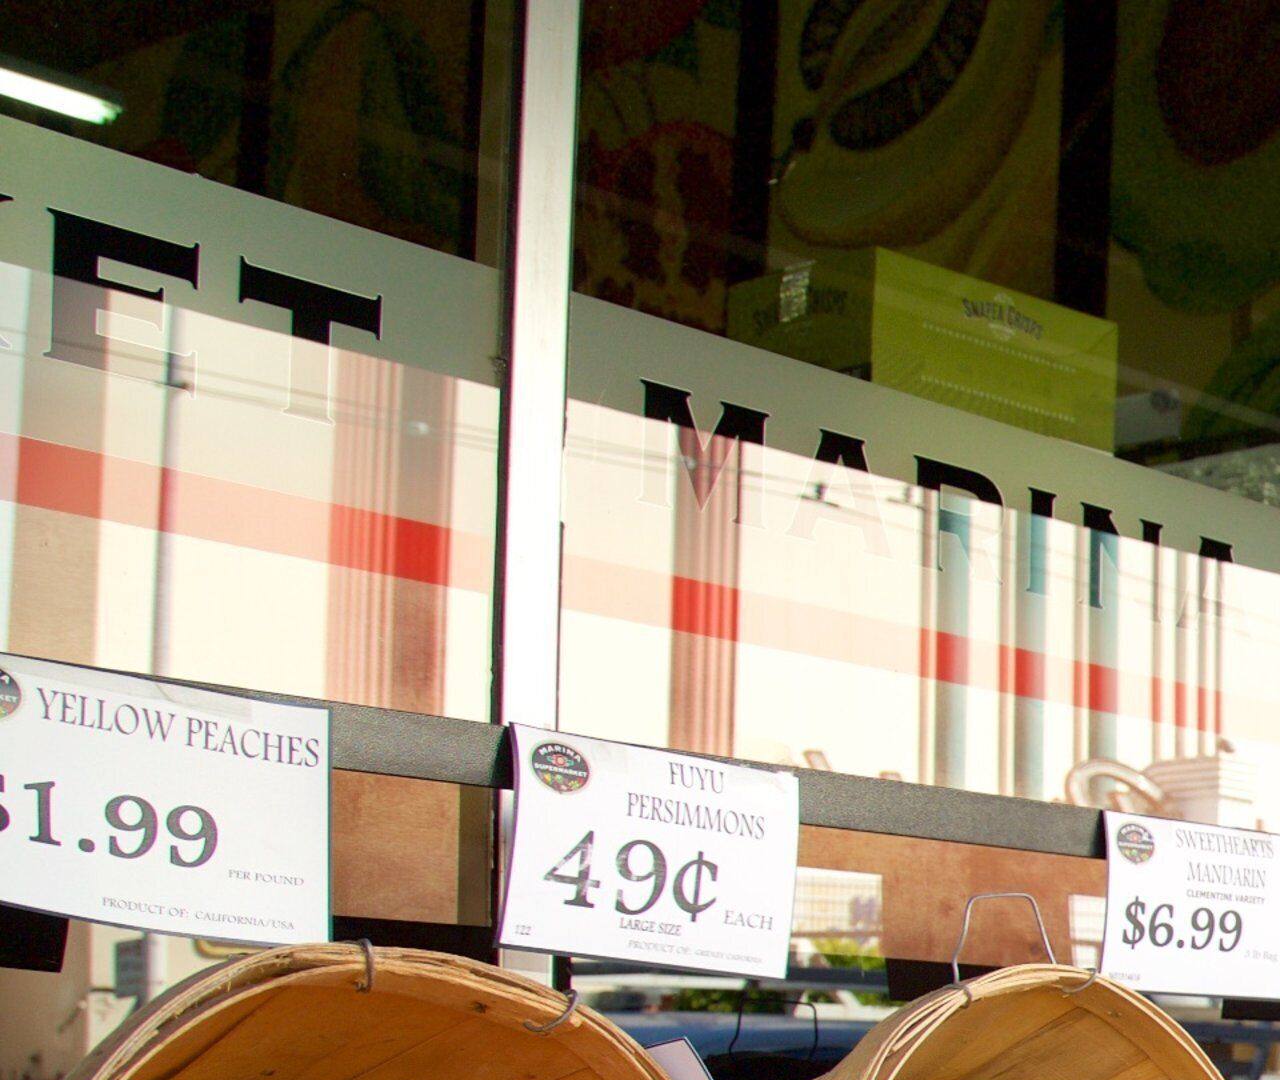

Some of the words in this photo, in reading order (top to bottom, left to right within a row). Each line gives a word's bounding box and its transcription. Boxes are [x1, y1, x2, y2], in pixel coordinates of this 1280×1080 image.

[36, 687, 176, 743] YELLOW
[184, 716, 321, 768] PEACHES
[669, 761, 725, 795] FUYU
[626, 792, 767, 840] PERSIMMONS
[1175, 828, 1275, 859] SWEETHEARTS
[228, 869, 251, 881] PER
[255, 872, 305, 887] POUND
[543, 829, 719, 923] 49¢
[1186, 861, 1267, 889] MANDARIN
[1186, 888, 1233, 902] CLEMENTINE
[1235, 895, 1266, 905] VARIETY
[101, 896, 166, 916] PRODUCT
[168, 907, 189, 919] OF:
[194, 910, 296, 931] CALIFORNIA/USA
[619, 916, 657, 933] LARGE
[658, 921, 682, 937] SIZE
[723, 910, 774, 931] EACH
[1122, 896, 1243, 952] $6.99
[627, 938, 676, 955] PRODUCT
